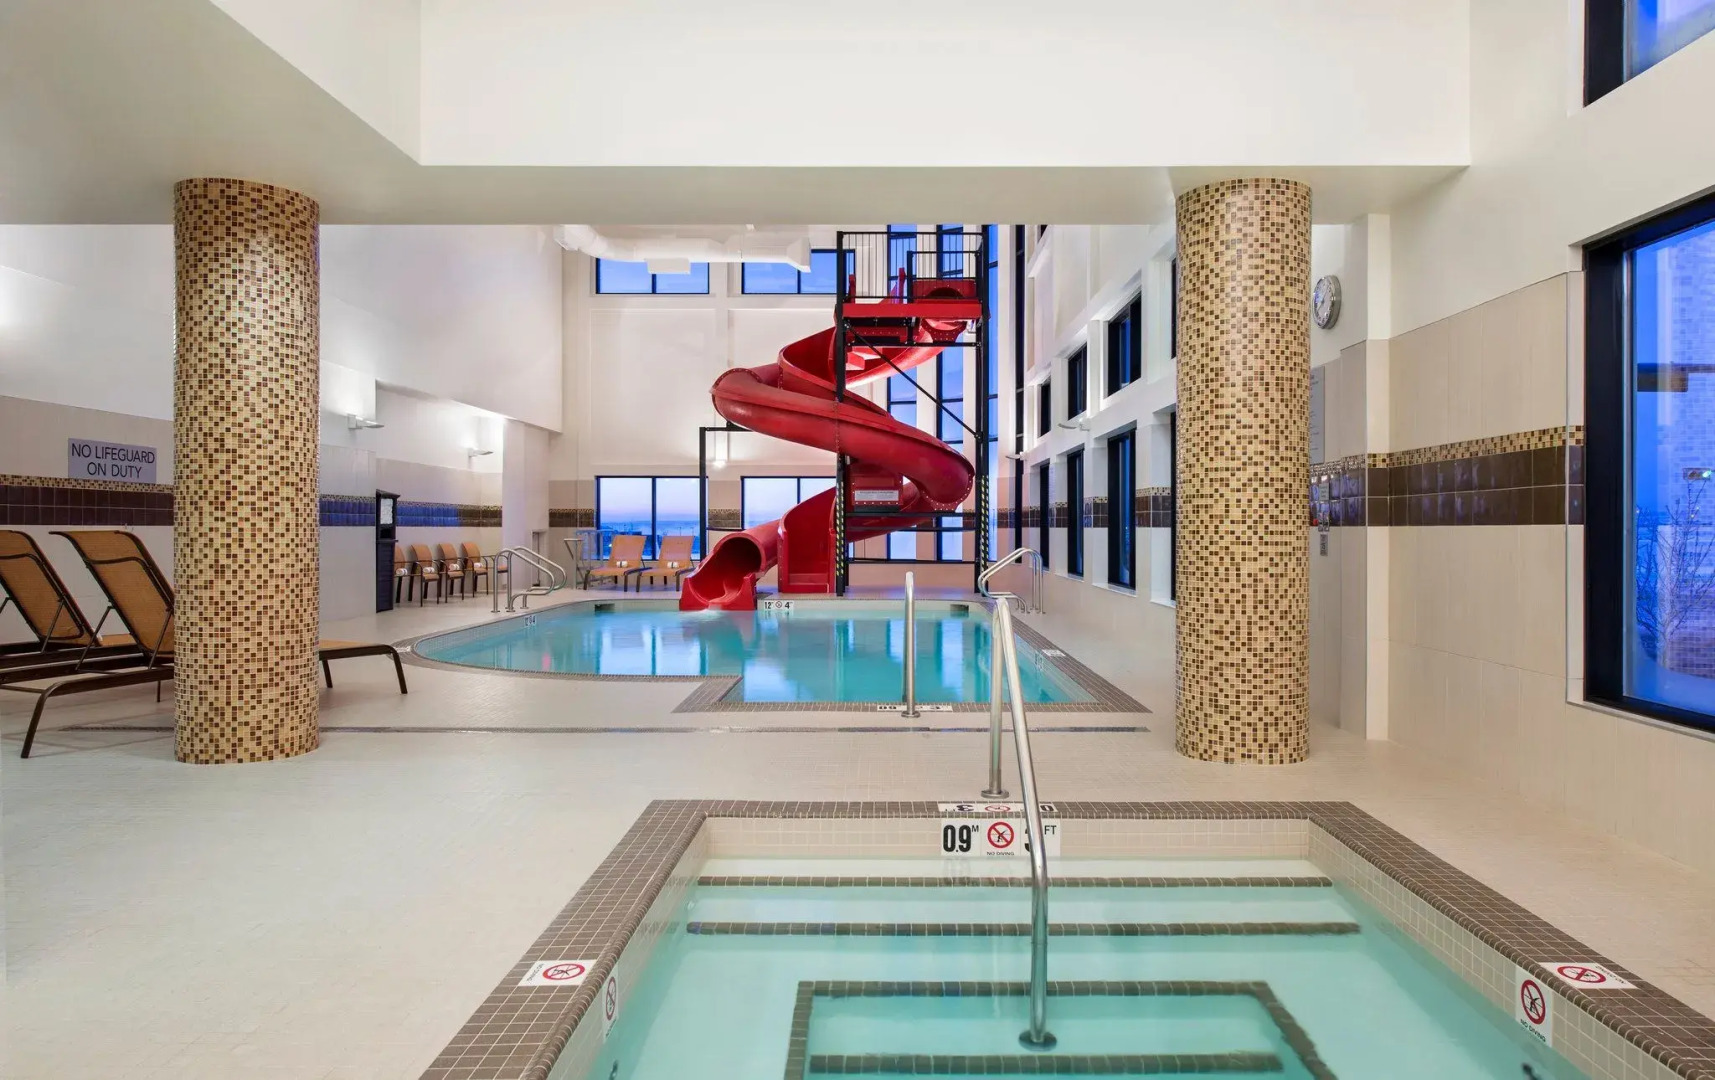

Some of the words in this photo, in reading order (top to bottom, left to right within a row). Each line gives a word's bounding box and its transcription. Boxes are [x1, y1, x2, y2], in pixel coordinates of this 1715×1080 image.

[71, 443, 92, 458] NO
[95, 445, 155, 464] LIFEGUARD
[87, 462, 107, 476] ON
[111, 464, 142, 479] DUTY
[942, 824, 972, 853] 0.9
[1044, 825, 1057, 835] FT
